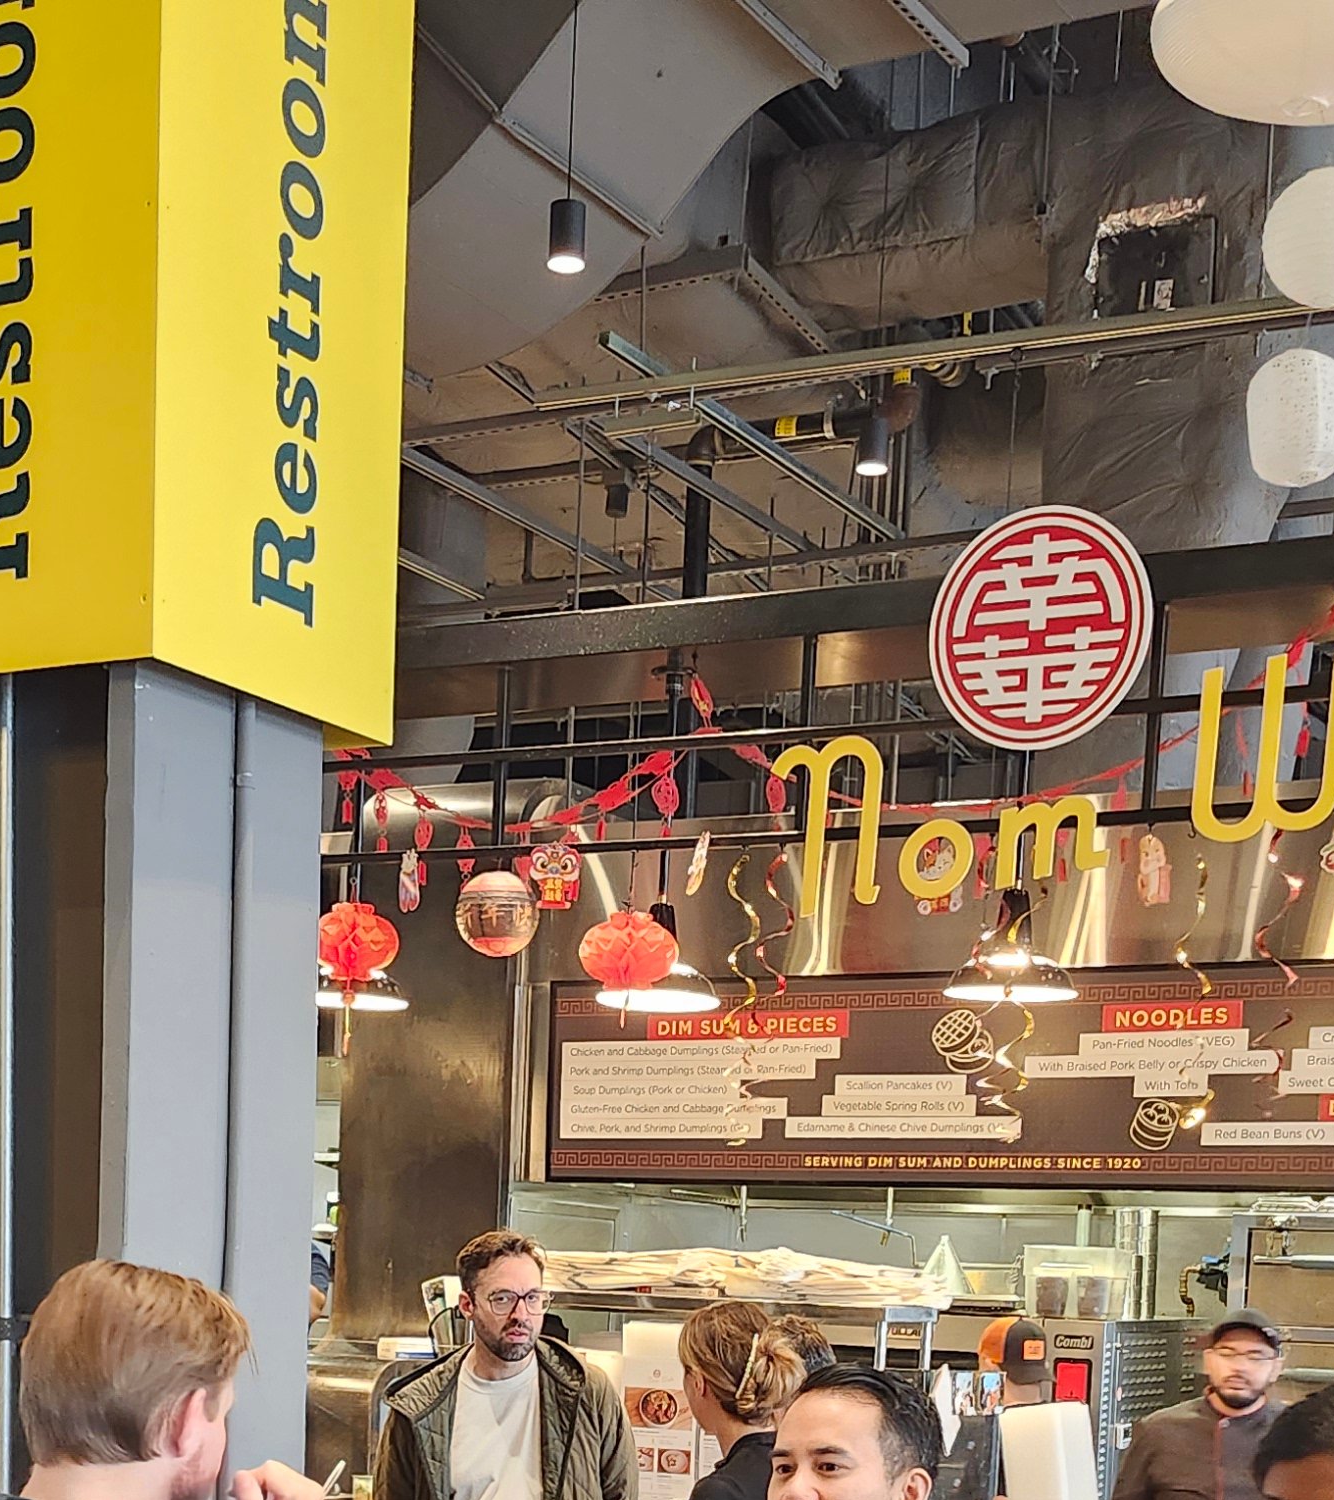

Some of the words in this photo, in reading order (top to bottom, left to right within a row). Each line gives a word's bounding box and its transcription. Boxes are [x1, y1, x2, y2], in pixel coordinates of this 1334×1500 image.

[771, 735, 1109, 918] Nom
[1115, 1007, 1229, 1028] NOODLES
[657, 1020, 692, 1036] DIM
[700, 1018, 741, 1036] SUM
[766, 1016, 838, 1035] PIECES
[1092, 1039, 1145, 1050] Pan-Fried
[1148, 1037, 1194, 1048] Noodles
[1201, 1036, 1235, 1048] VEG)
[570, 1047, 605, 1057] Chicken
[607, 1047, 624, 1057] and
[627, 1046, 668, 1058] Cabbage
[670, 1045, 719, 1058] Dumplings
[769, 1046, 779, 1054] or
[782, 1043, 833, 1054] Pan-Fried)
[570, 1066, 590, 1076] Pork
[592, 1066, 609, 1076] and
[611, 1066, 643, 1078] Shrimp
[646, 1065, 694, 1077] Dumplings
[757, 1063, 807, 1075] Pan-Fried)
[1039, 1061, 1064, 1072] With
[1067, 1060, 1106, 1071] Braised
[1110, 1060, 1135, 1070] Pork
[1138, 1059, 1164, 1072] Belly
[1168, 1060, 1180, 1069] or
[1184, 1057, 1219, 1071] Crispy
[1222, 1057, 1267, 1068] Chicken
[846, 1080, 883, 1091] Scallion
[886, 1080, 933, 1091] Pancakes
[936, 1079, 953, 1092] (V)
[1145, 1080, 1170, 1091] With
[1288, 1077, 1323, 1089] Sweet
[573, 1085, 595, 1096] Soup
[598, 1085, 646, 1097] Dumplings
[648, 1084, 672, 1096] (Pork
[675, 1086, 685, 1095] or
[688, 1084, 728, 1096] Chicken)
[570, 1104, 622, 1114] Gluten-Free
[624, 1104, 660, 1114] Chicken
[662, 1103, 679, 1113] and
[682, 1103, 724, 1116] Cabbage
[833, 1101, 882, 1113] Vegetable
[885, 1101, 917, 1113] Spring
[921, 1101, 945, 1111] Rolls
[947, 1101, 965, 1113] (V)
[624, 1123, 642, 1133] and
[644, 1123, 676, 1135] Shrimp
[679, 1122, 727, 1135] Dumplings
[730, 1122, 751, 1134] (G)
[797, 1122, 845, 1132] Edamame
[847, 1122, 855, 1132] &
[858, 1122, 896, 1132] Chinese
[899, 1122, 927, 1132] Chive
[931, 1122, 984, 1134] Dumplings
[1214, 1128, 1236, 1139] Red
[1240, 1128, 1270, 1139] Bean
[1273, 1128, 1302, 1139] Buns
[1305, 1128, 1325, 1141] (V)
[804, 1155, 863, 1168] SERVING
[868, 1155, 893, 1168] DIM
[898, 1156, 928, 1168] SUM
[933, 1156, 963, 1168] AND
[968, 1156, 1052, 1169] DUMPLINGS
[1057, 1157, 1101, 1169] SINCE
[1106, 1157, 1142, 1169] 1920
